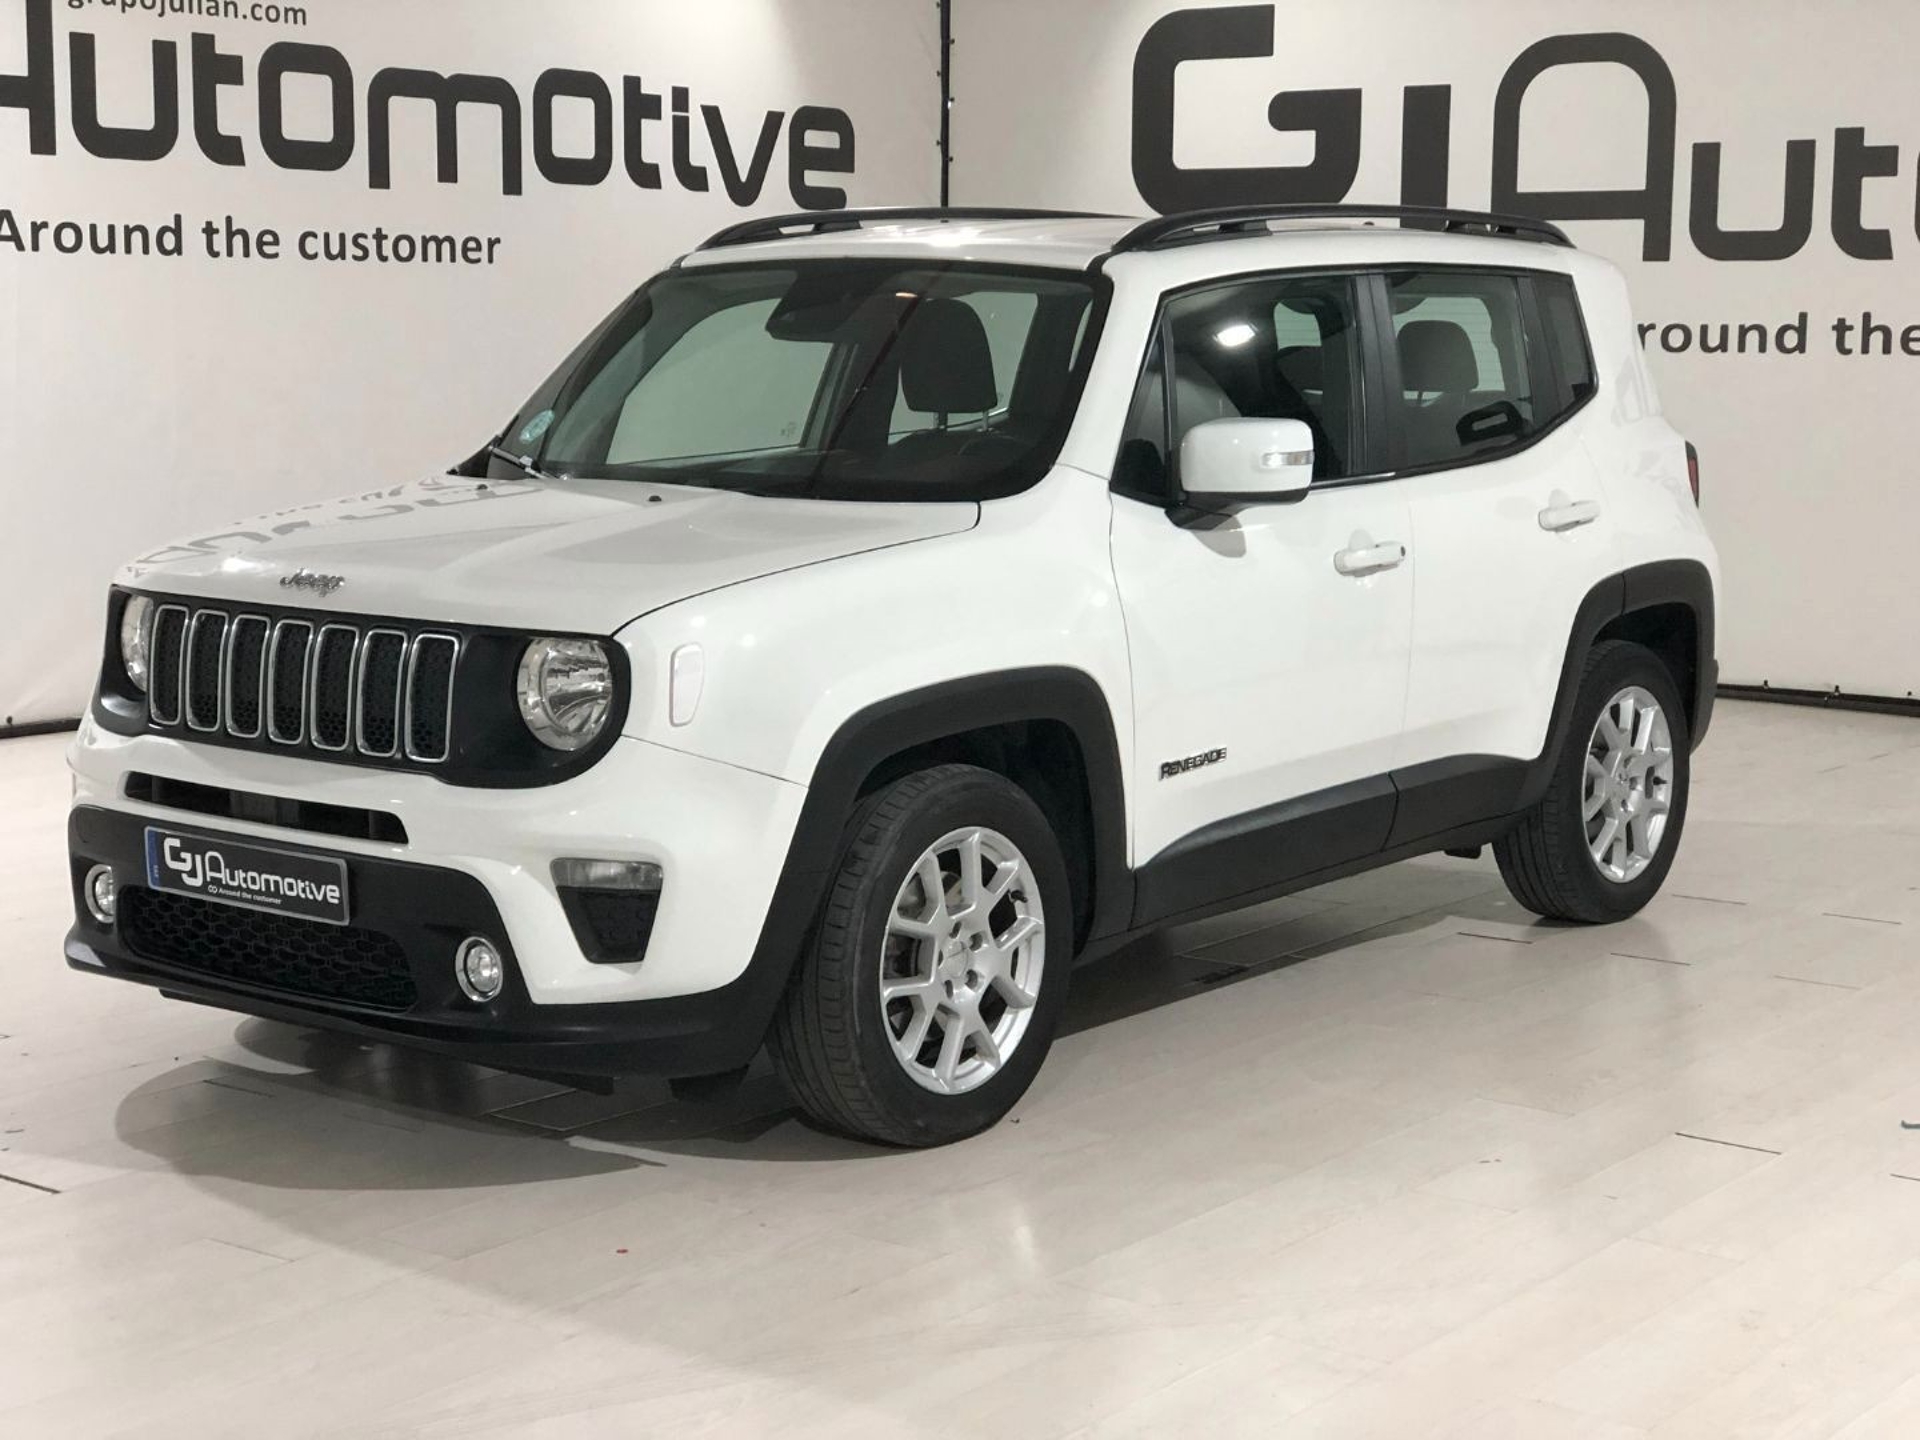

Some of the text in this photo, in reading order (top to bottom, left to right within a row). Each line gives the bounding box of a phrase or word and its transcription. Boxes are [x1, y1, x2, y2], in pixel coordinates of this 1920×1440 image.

[67, 0, 307, 25] pojulian.com
[0, 209, 501, 265] Around the customer
[1637, 311, 1808, 355] round
[1158, 747, 1227, 781] RENEGADE
